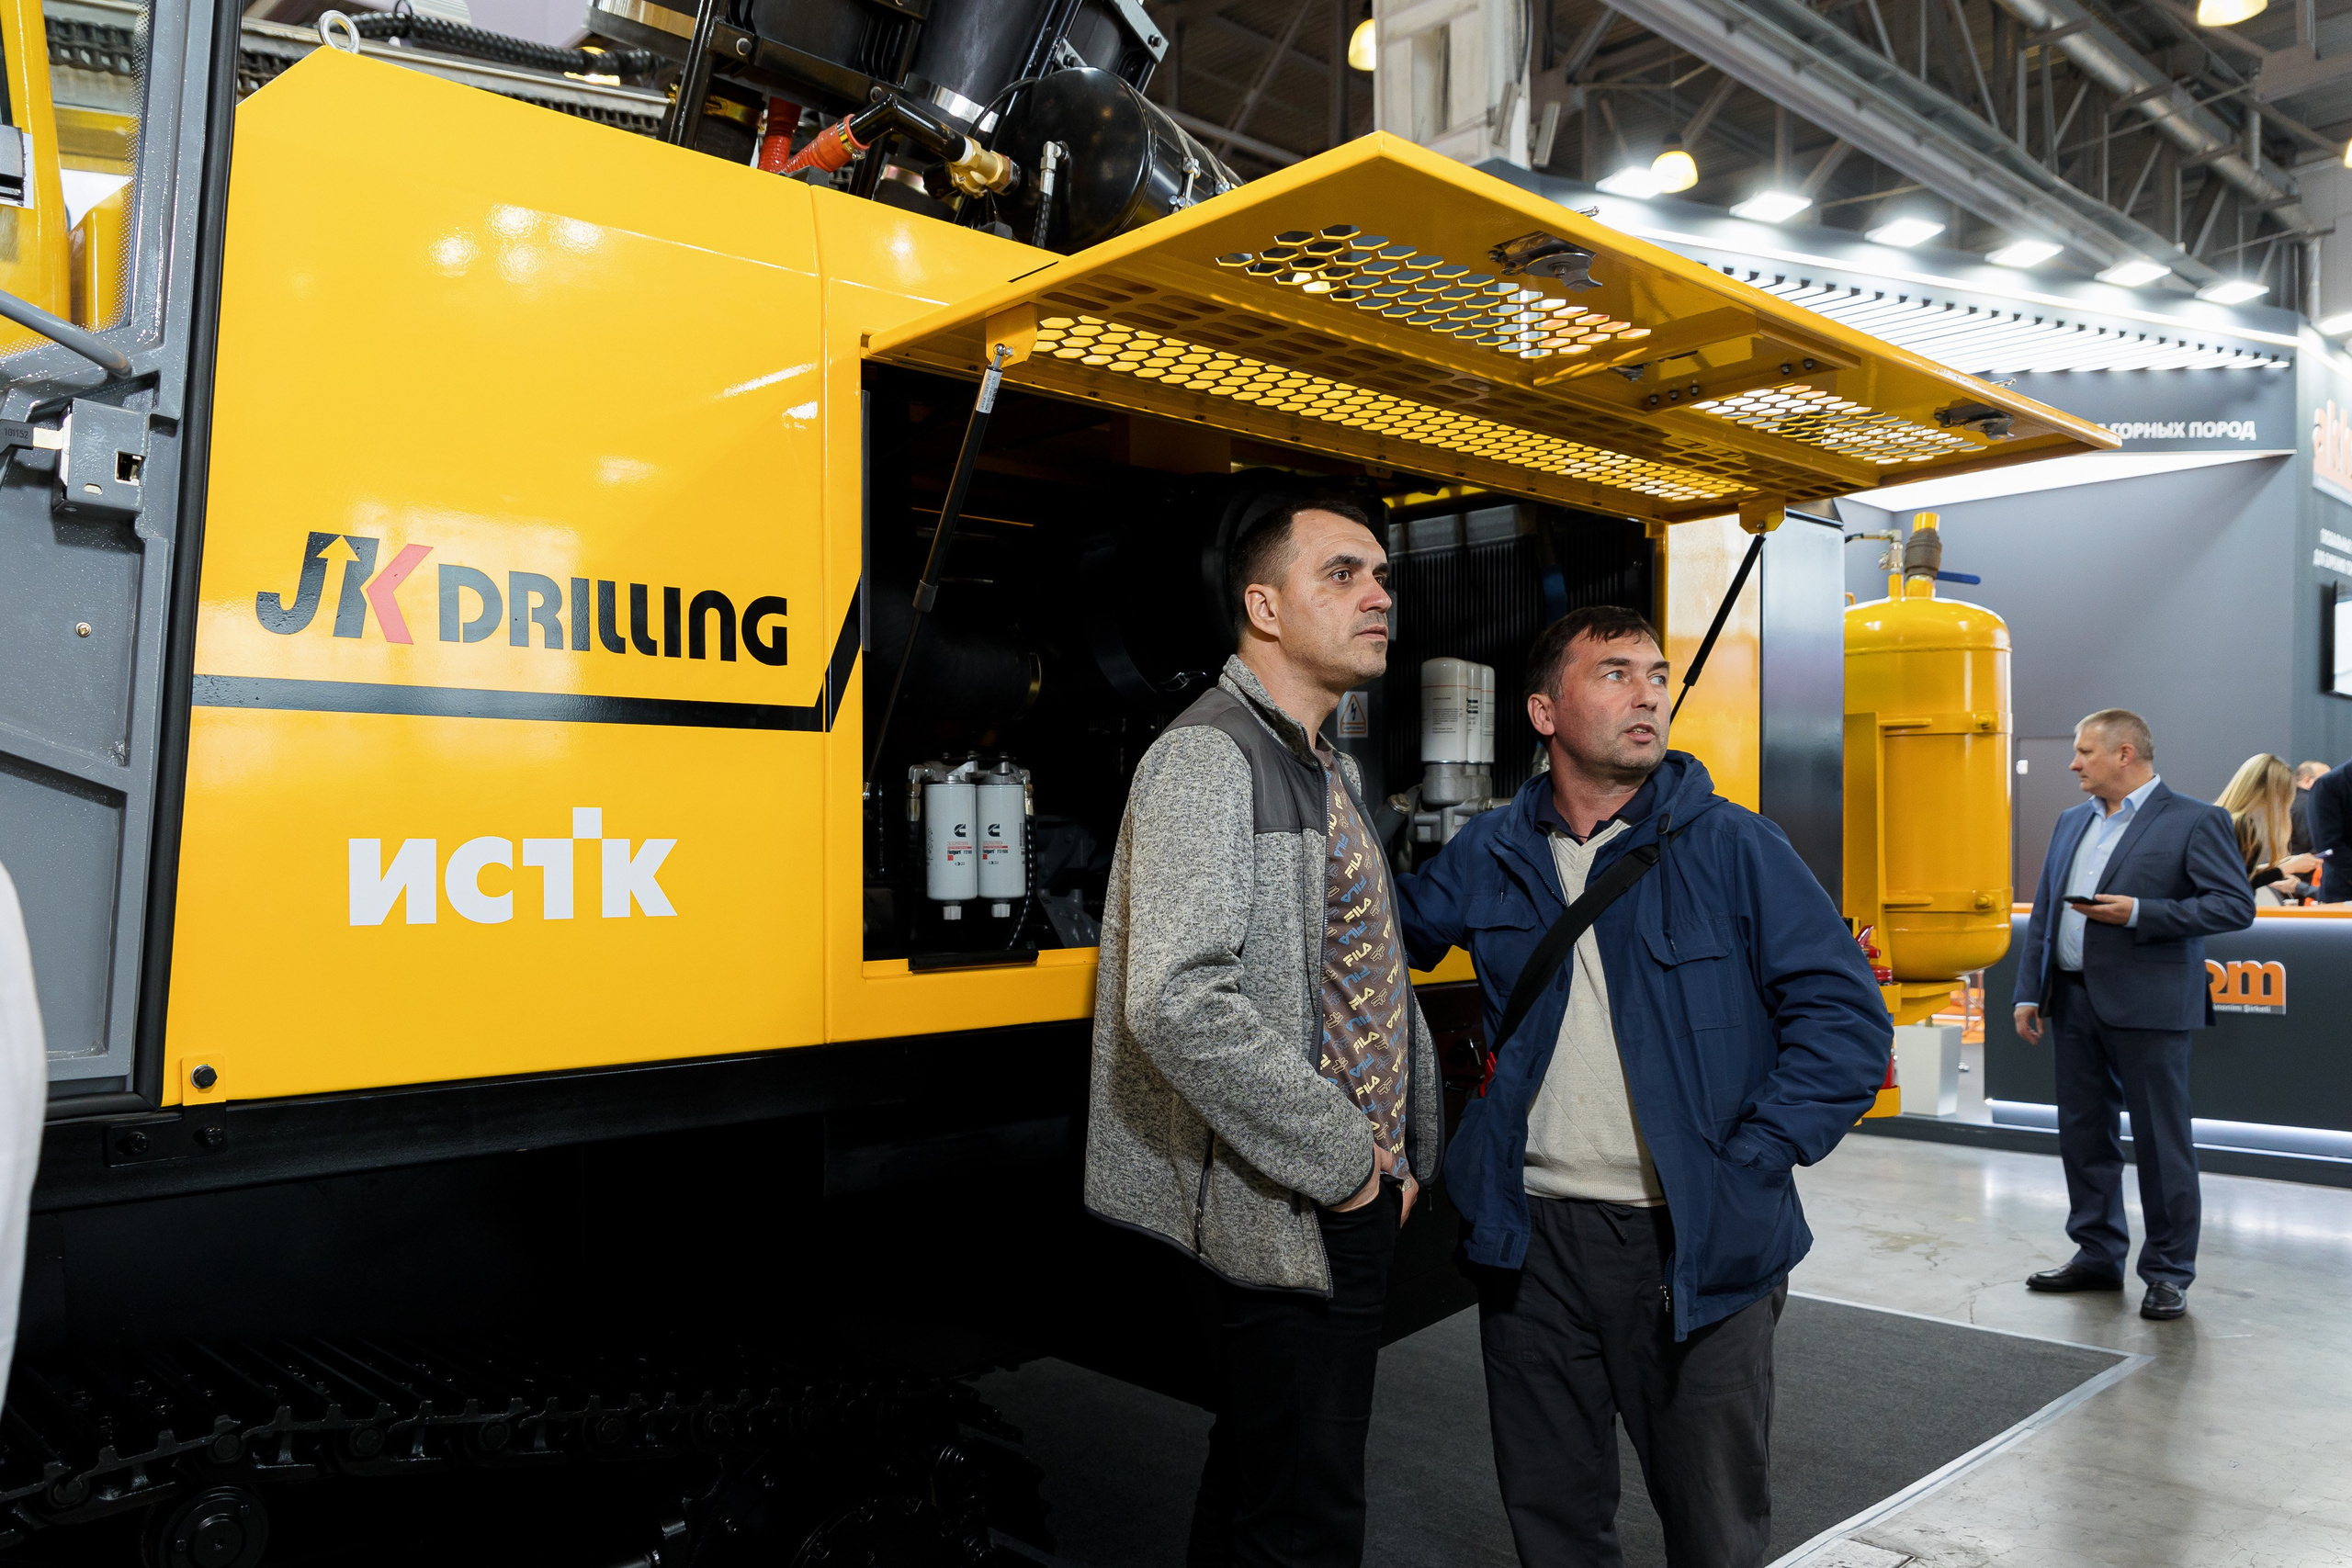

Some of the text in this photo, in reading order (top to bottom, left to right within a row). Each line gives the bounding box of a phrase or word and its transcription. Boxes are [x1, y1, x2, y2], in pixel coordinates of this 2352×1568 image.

[2188, 421, 2256, 441] ПОРОД
[255, 531, 788, 667] JK DRILLING
[1333, 832, 1349, 857] FILA
[348, 807, 678, 927] ИСТК
[1344, 852, 1363, 879] FILA
[1340, 874, 1366, 903] FILA
[1343, 897, 1372, 923] FILA
[1339, 920, 1368, 945] FILA
[1342, 942, 1373, 967] FILA
[1341, 964, 1371, 989] FILA
[1348, 987, 1374, 1010] FILA
[1353, 1032, 1380, 1055] FILA
[1349, 1053, 1374, 1077] FILA
[1355, 1075, 1381, 1100] FILA
